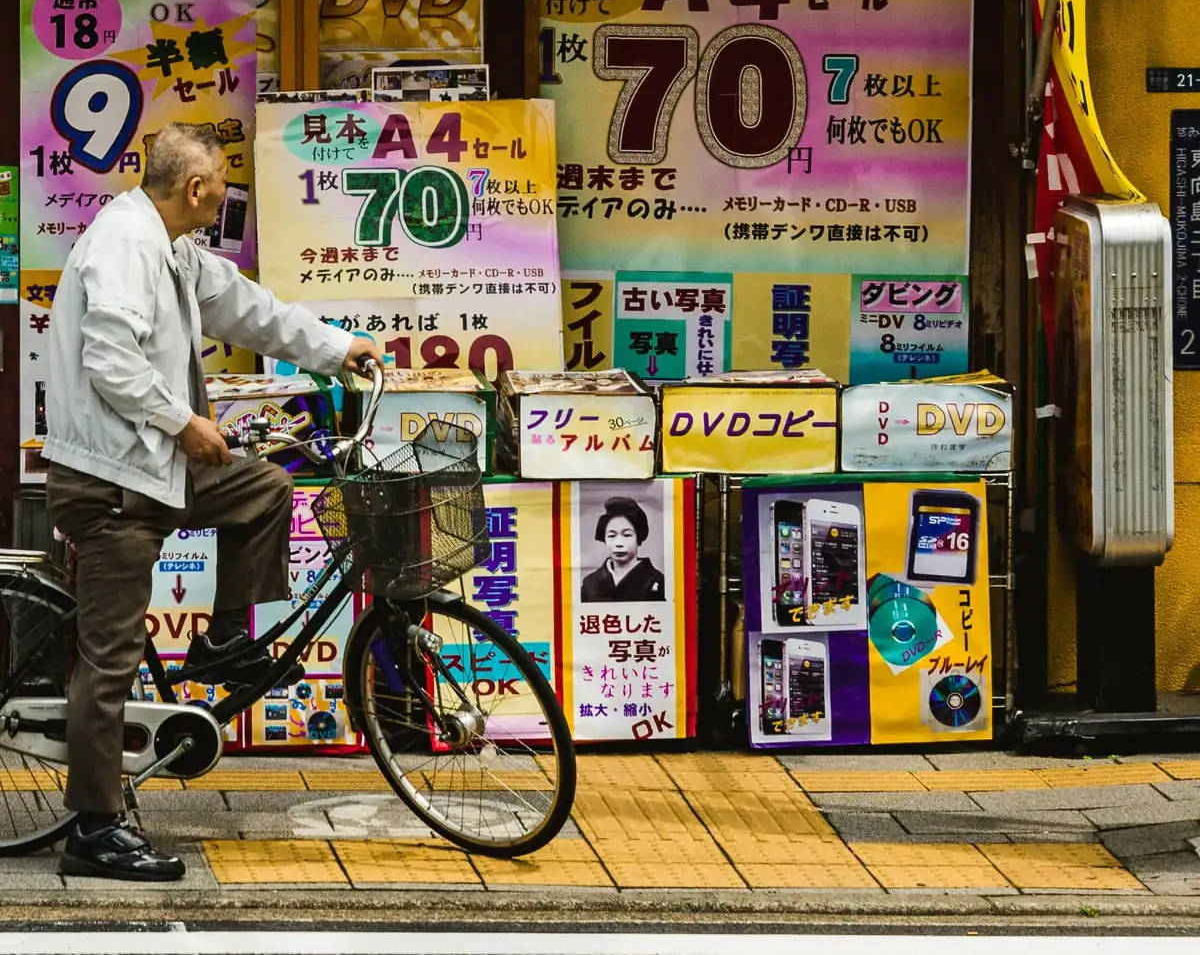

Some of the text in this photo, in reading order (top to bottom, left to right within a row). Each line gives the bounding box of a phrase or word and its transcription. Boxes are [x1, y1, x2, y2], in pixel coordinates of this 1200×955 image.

[151, 3, 194, 22] OK
[146, 29, 229, 76] 半額
[173, 68, 240, 103] セール
[311, 146, 355, 162] 付けて
[472, 137, 527, 159] セール
[300, 246, 399, 264] 今週末まで
[623, 287, 726, 312] 古い写真
[862, 282, 958, 306] ダビング
[460, 312, 488, 331] 1枚
[628, 331, 680, 356] 写真
[527, 408, 599, 430] フリー
[669, 410, 836, 438] DVDコピー
[915, 403, 1006, 436] DVD
[946, 532, 970, 551] 16
[579, 614, 660, 636] 退色した
[958, 589, 974, 652] コピー
[608, 639, 670, 662] 写真が
[580, 664, 658, 682] きれいに
[927, 654, 988, 676] ブルーレイ
[471, 678, 520, 695] OK
[600, 681, 674, 700] なります
[631, 710, 675, 740] OK
